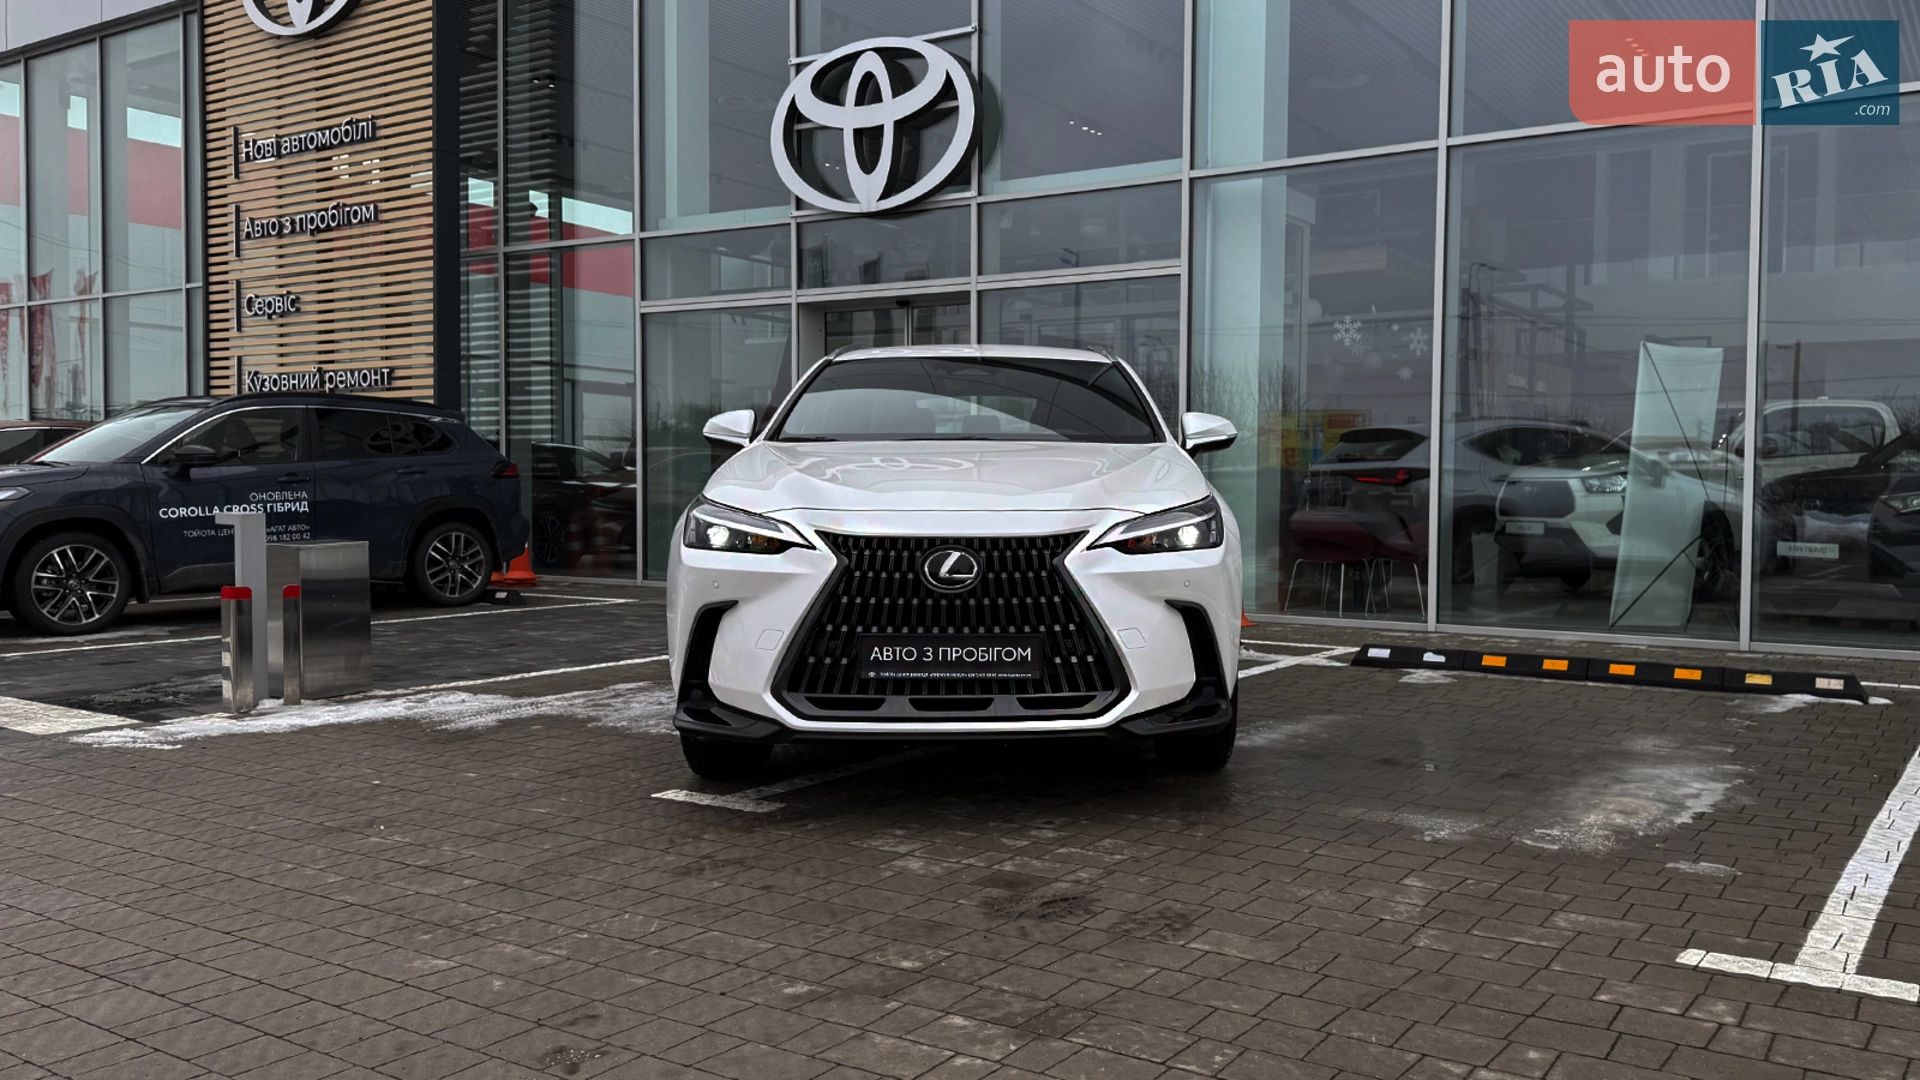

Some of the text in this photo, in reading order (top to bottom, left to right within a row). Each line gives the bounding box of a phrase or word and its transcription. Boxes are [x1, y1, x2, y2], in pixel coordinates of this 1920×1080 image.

[243, 115, 372, 161] Нові автомобілі
[243, 201, 376, 239] Авто з пробігом
[244, 289, 297, 319] Сервіс
[245, 366, 390, 393] Кузовний ремонт
[249, 491, 308, 501] ОНОВЛЕНА
[159, 501, 310, 518] COROLLA CROSS ГІБРИД
[183, 529, 217, 538] ТОЙОТА
[217, 528, 235, 537] ЦЕН
[302, 532, 311, 540] 42
[870, 646, 1032, 662] АВТО З ПРОБІГОМ
